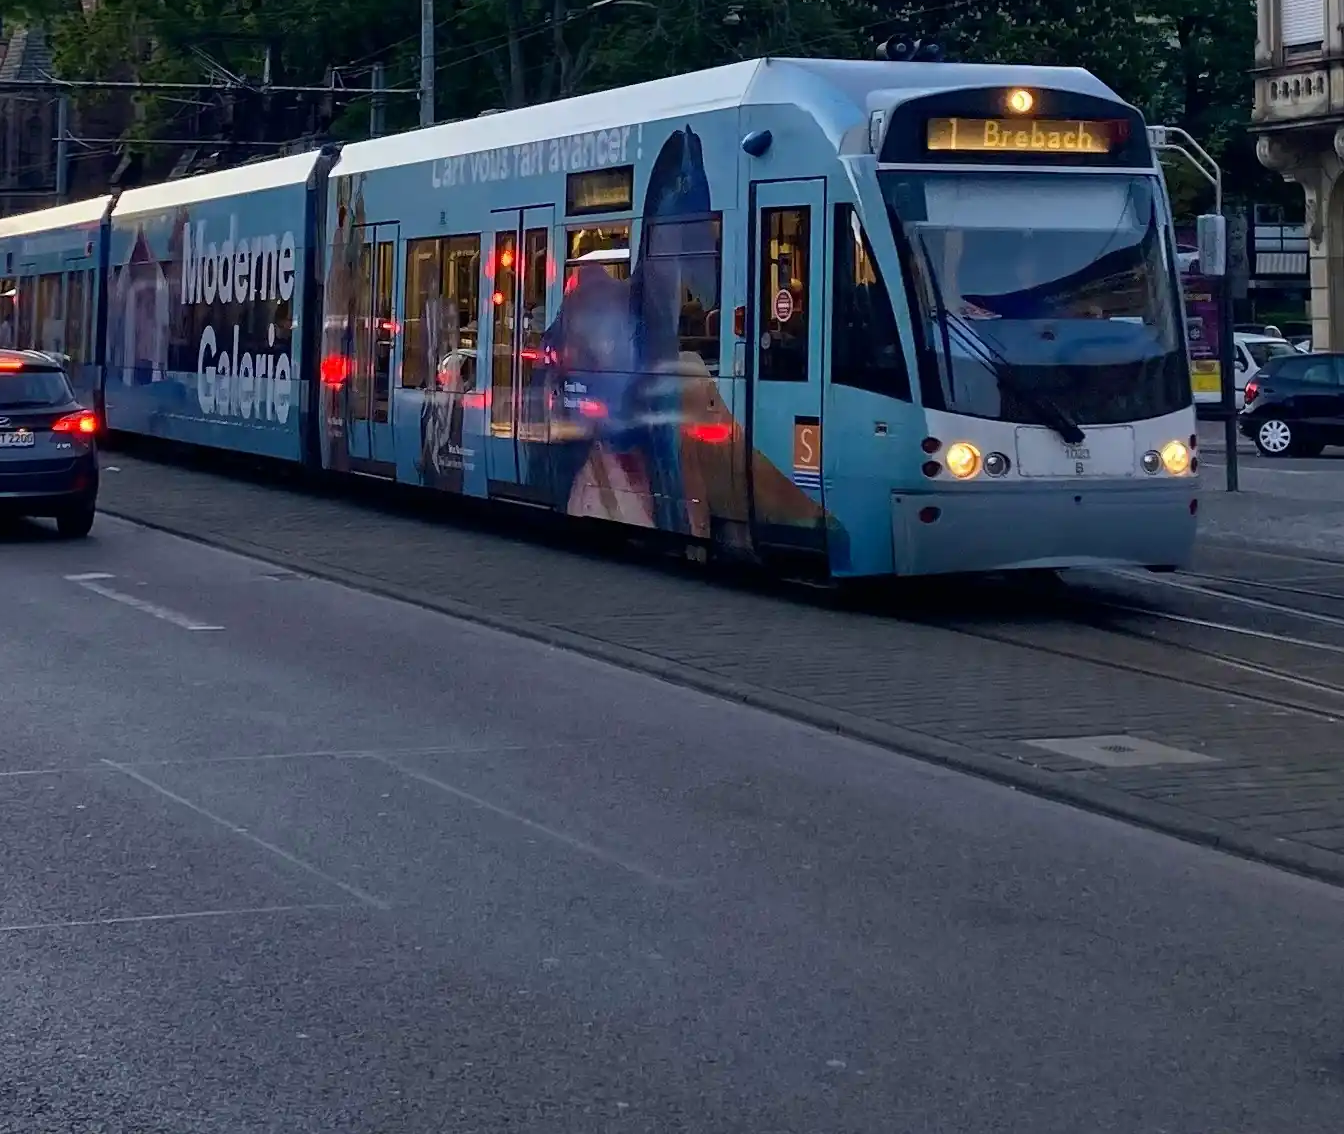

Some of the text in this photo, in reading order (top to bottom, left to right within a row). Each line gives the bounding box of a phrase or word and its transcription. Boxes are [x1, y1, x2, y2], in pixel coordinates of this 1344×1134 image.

[432, 153, 467, 189] Lart
[548, 126, 631, 173] avancer
[983, 120, 1093, 149] Brebach
[181, 213, 296, 305] Moderne
[197, 322, 293, 425] Galerie
[798, 427, 814, 463] S
